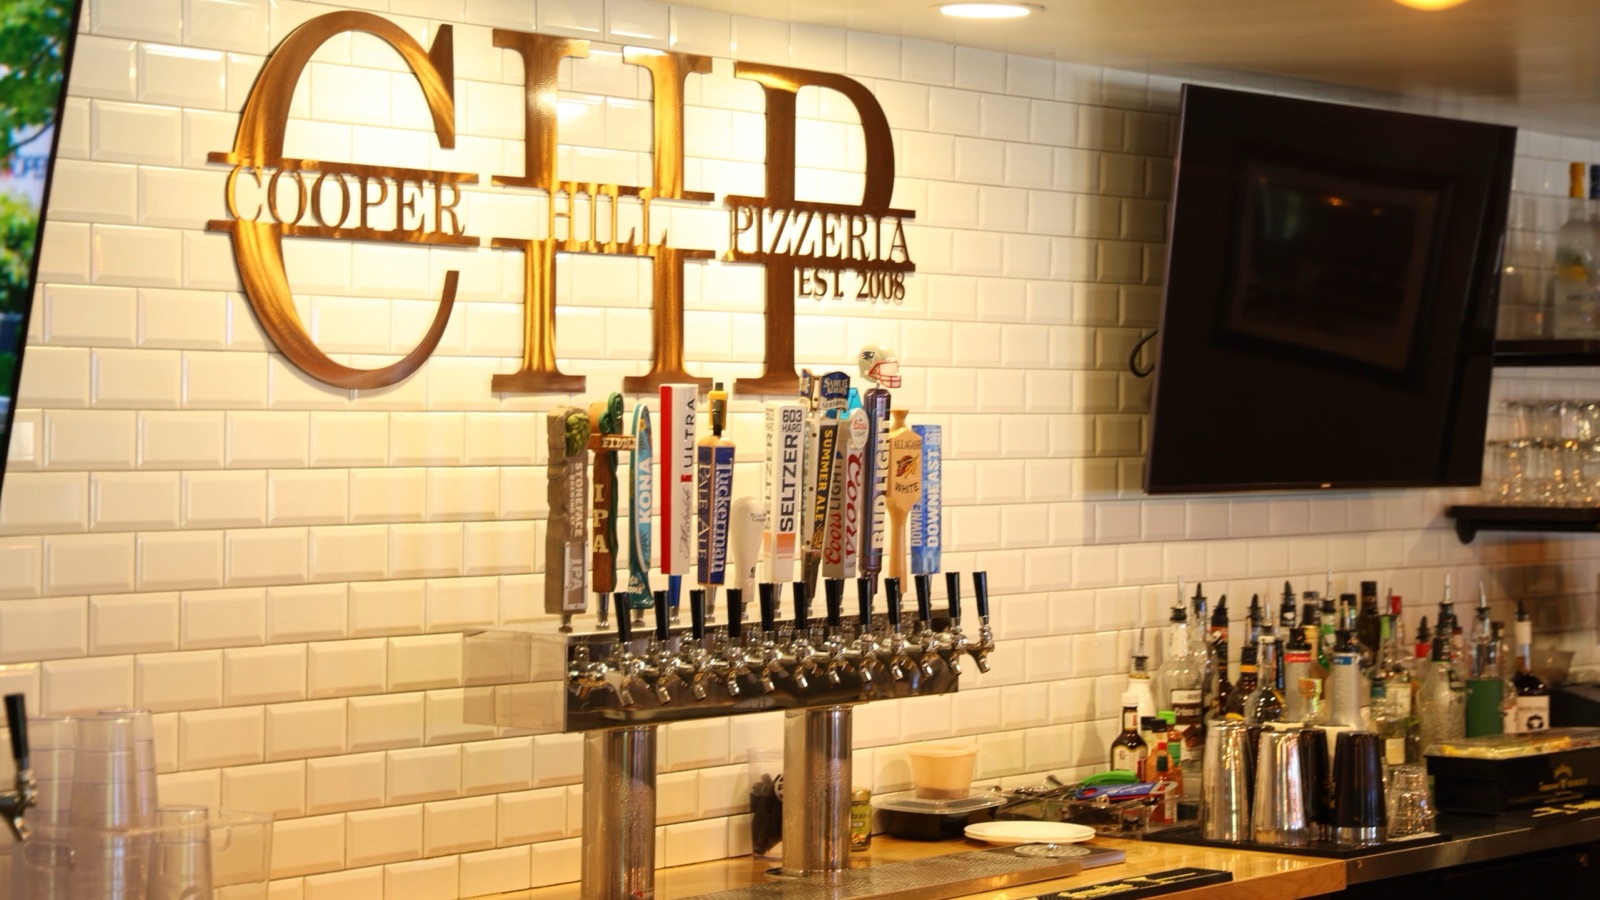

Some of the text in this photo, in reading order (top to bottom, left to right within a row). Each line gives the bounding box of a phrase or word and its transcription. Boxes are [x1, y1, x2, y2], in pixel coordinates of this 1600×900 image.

[226, 165, 466, 237] COOPER
[548, 182, 668, 253] HILL
[728, 200, 914, 266] PIZZERIA
[857, 270, 906, 300] 2008
[683, 398, 696, 468] ULTRA
[782, 423, 802, 433] HARD
[783, 409, 803, 423] 603
[574, 462, 583, 537] STONEFACE
[638, 457, 653, 524] KONA
[779, 434, 799, 532] SELTZER
[815, 429, 833, 522] SUMMER ALE
[845, 452, 862, 558] Coors
[871, 416, 890, 549] BUD LIGHT
[895, 481, 920, 494] WHITE
[927, 448, 940, 548] DOWNEAST
[593, 484, 609, 553] IPA
[698, 464, 711, 559] PALE ALE
[714, 458, 733, 573] Tuckerman
[824, 512, 842, 565] Coors
[911, 499, 923, 547] DOWNE
[570, 559, 583, 591] IPA
